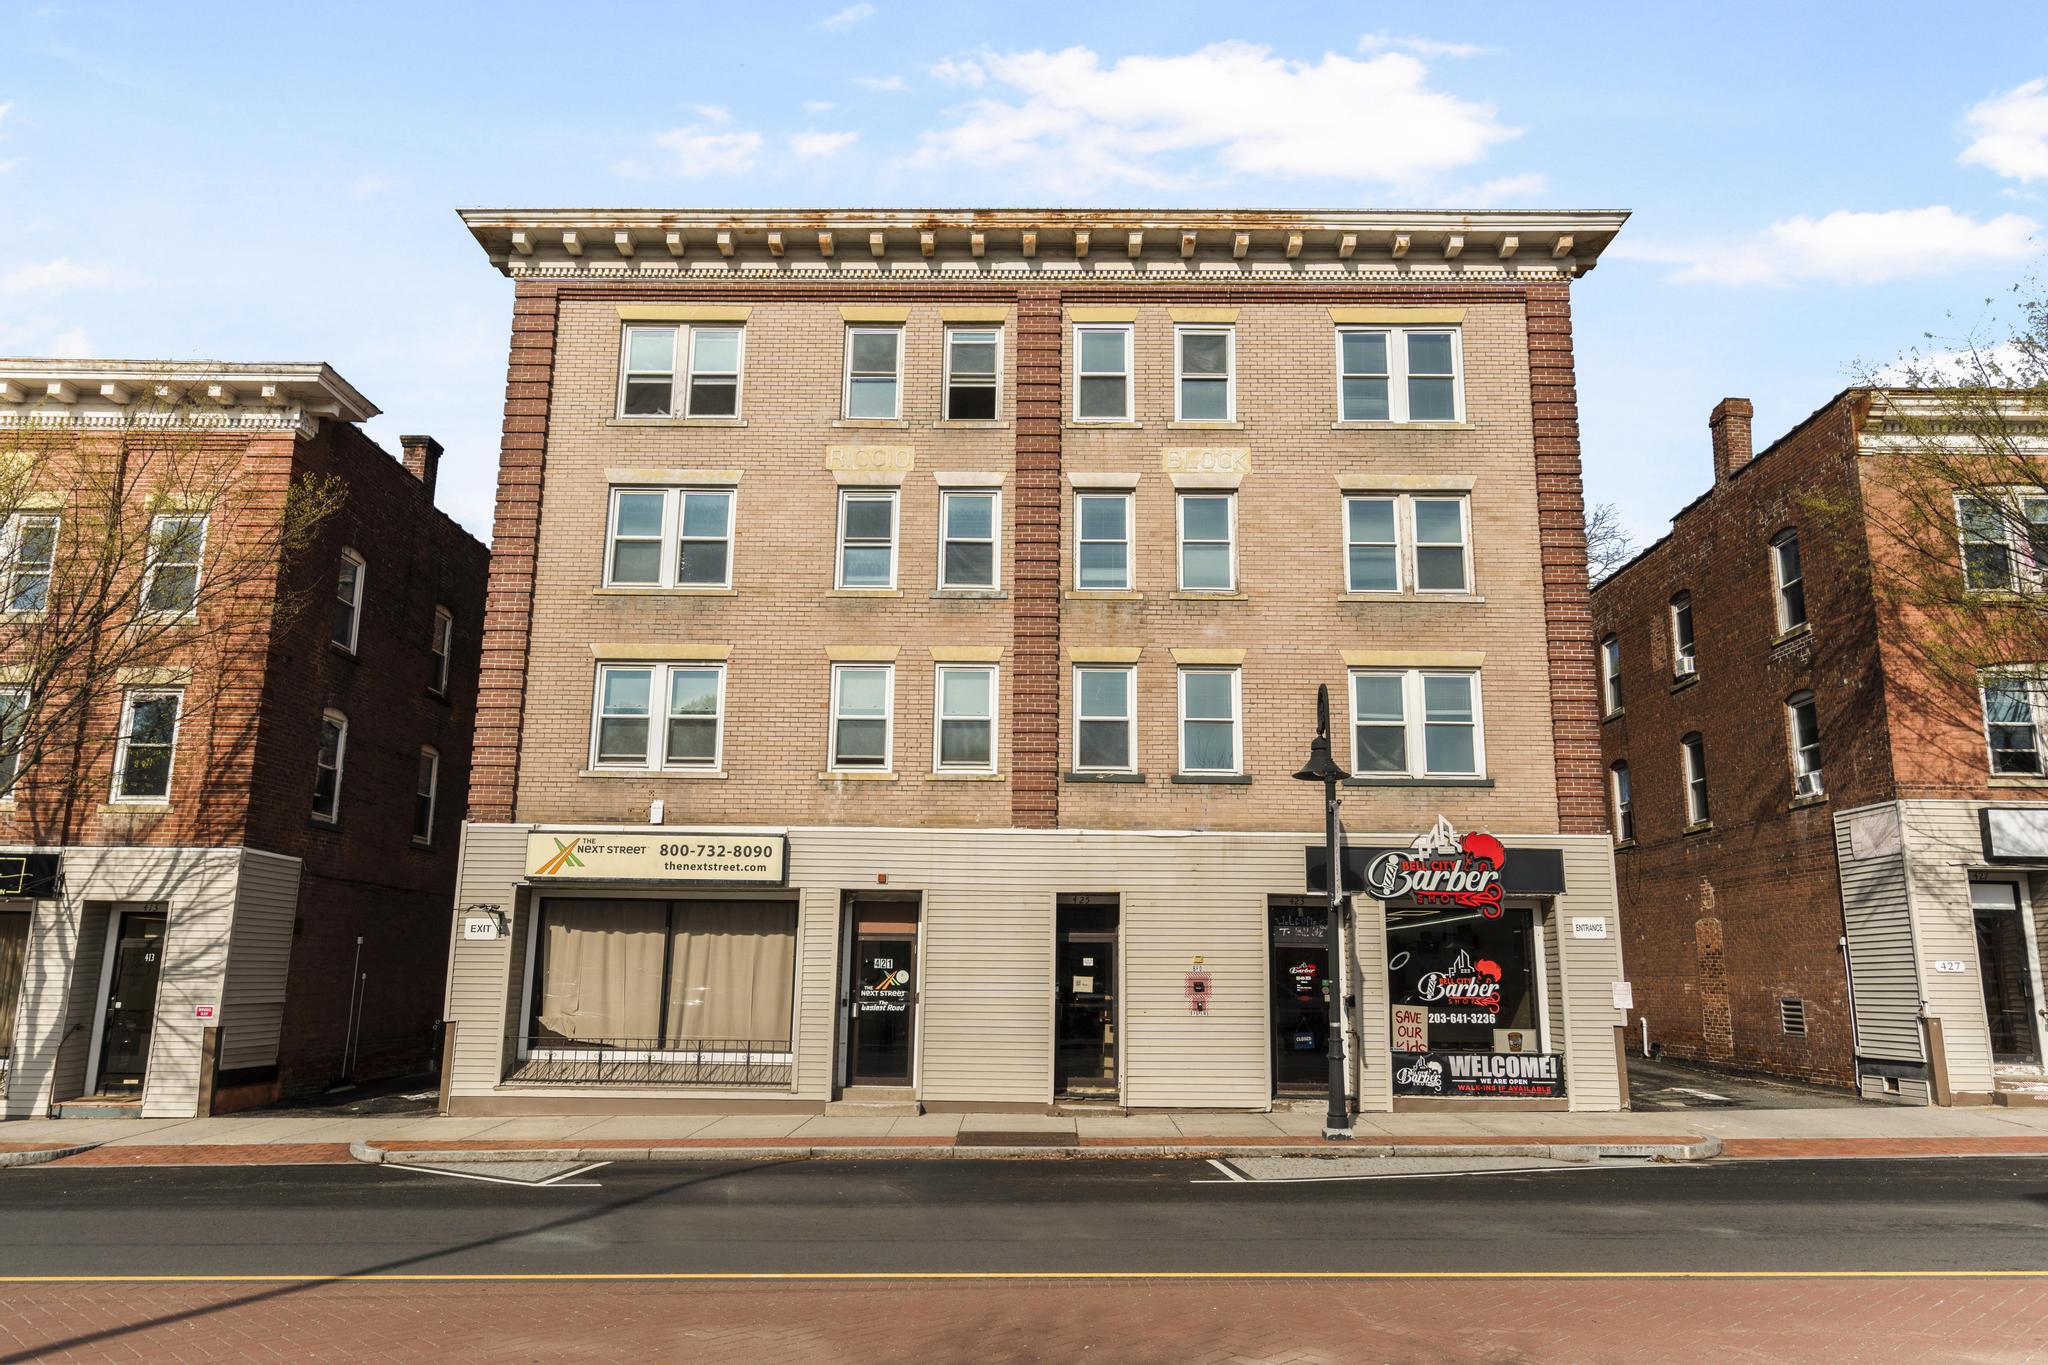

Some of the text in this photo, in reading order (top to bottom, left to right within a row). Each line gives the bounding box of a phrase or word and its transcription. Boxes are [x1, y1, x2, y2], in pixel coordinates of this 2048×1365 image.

[831, 448, 911, 468] RICCIO
[1167, 450, 1249, 471] BLOCK
[660, 844, 773, 858] 800-732-8090
[664, 861, 767, 872] thenextstreet.com
[1402, 861, 1456, 871] BELL CITY
[1367, 851, 1499, 898] Barber
[470, 924, 492, 933] EXIT
[144, 953, 155, 962] 413
[873, 958, 893, 969] 421
[1940, 962, 1961, 971] 427
[1417, 971, 1500, 1002] Barber
[1395, 1010, 1422, 1024] SAVE
[1428, 1013, 1496, 1024] 203-641-3236
[1397, 1025, 1423, 1039] OUR
[1449, 1055, 1558, 1079] WELCOME!
[1396, 1067, 1442, 1085] Barber
[1508, 1085, 1552, 1093] AVAILABLE
